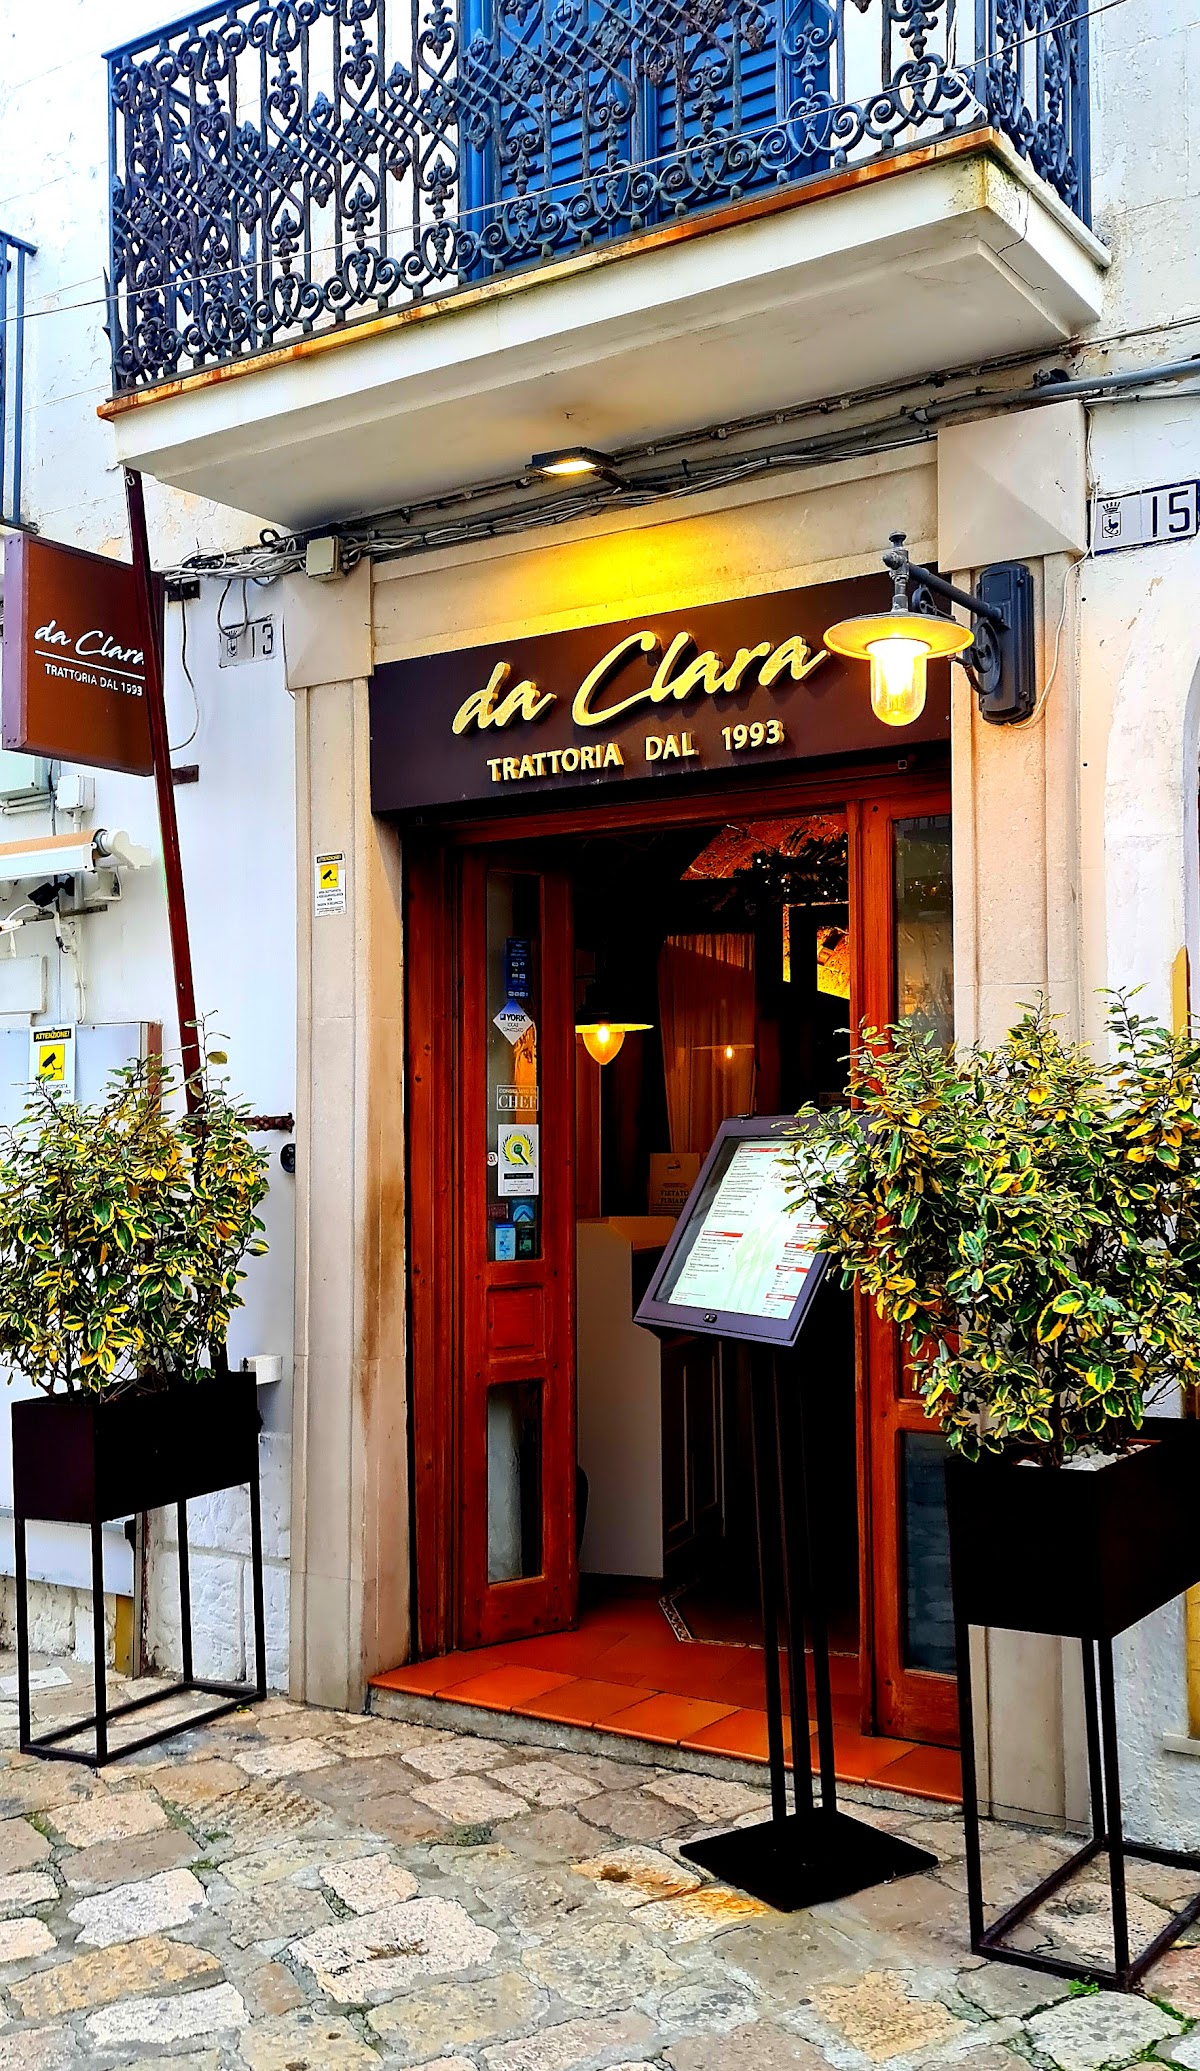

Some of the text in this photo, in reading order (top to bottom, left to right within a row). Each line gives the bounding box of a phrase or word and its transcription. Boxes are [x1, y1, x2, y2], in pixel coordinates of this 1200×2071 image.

[1152, 489, 1190, 537] 15
[34, 619, 145, 666] da Clara
[251, 623, 275, 656] 13
[45, 663, 143, 697] TRATTORIA DAL 1993
[452, 630, 832, 735] da Clara
[487, 719, 785, 783] TRATTORIA DAL 1993
[35, 1030, 70, 1041] ATTENZIONE!
[506, 1013, 526, 1022] YORK
